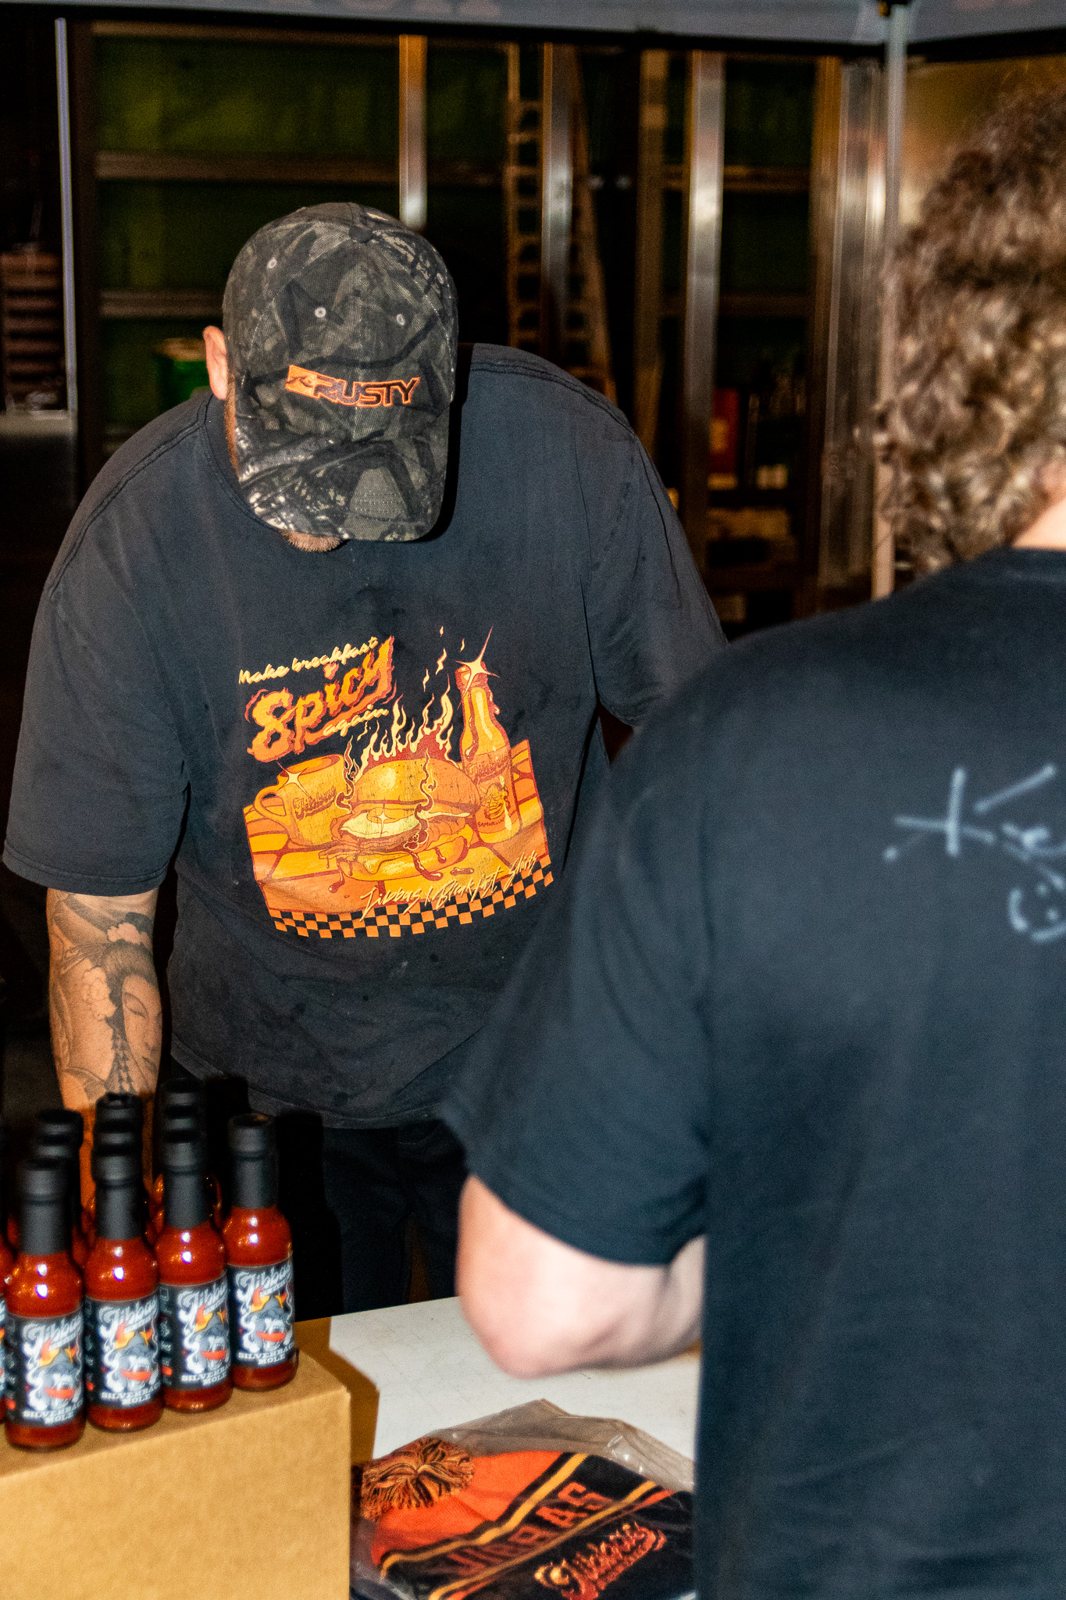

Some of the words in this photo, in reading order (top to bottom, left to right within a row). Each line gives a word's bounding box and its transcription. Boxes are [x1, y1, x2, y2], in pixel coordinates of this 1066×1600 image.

[313, 373, 421, 408] RUSTY
[238, 668, 289, 685] Make
[292, 636, 379, 671] breakfast
[245, 636, 395, 763] Spicy
[322, 706, 390, 737] again
